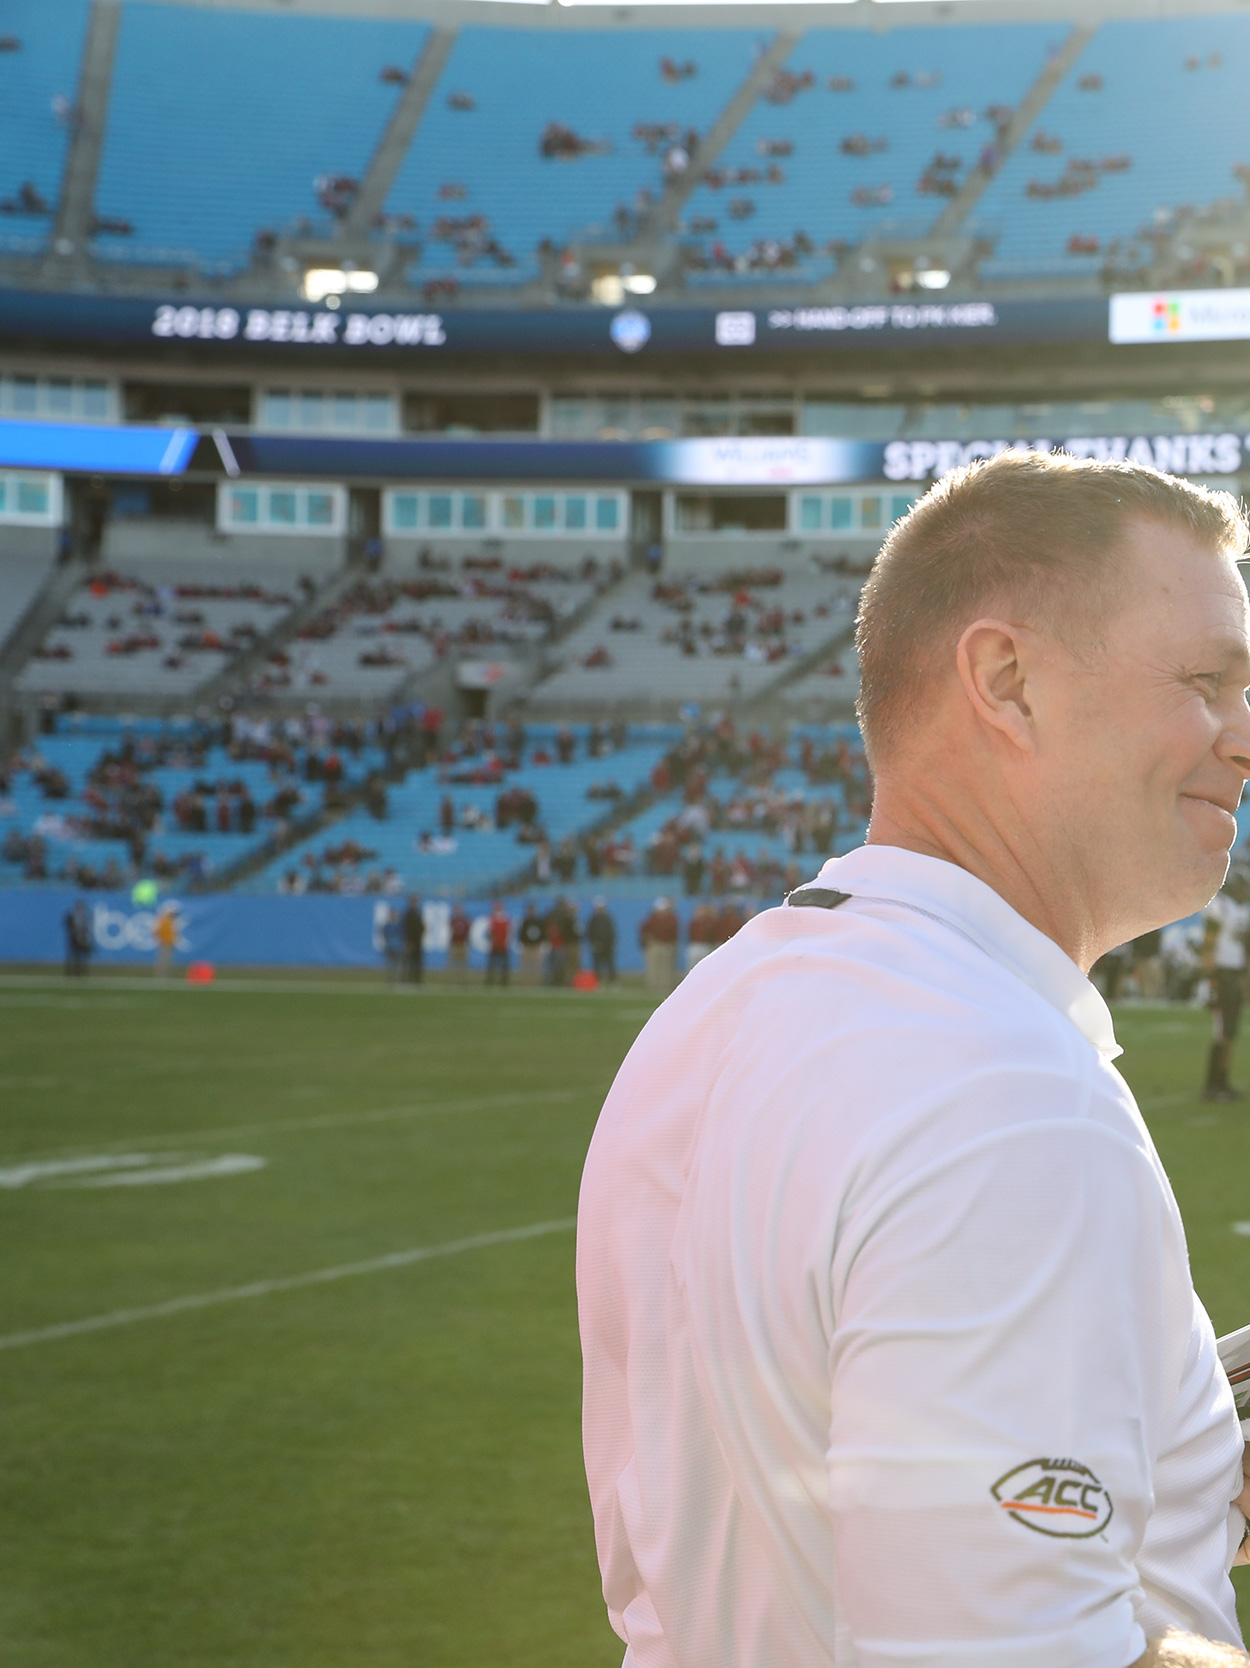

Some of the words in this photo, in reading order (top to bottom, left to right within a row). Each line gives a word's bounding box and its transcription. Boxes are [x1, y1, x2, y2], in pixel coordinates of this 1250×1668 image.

[243, 308, 342, 344] BELK
[342, 313, 448, 346] BOWL
[1011, 1475, 1105, 1514] ACC
